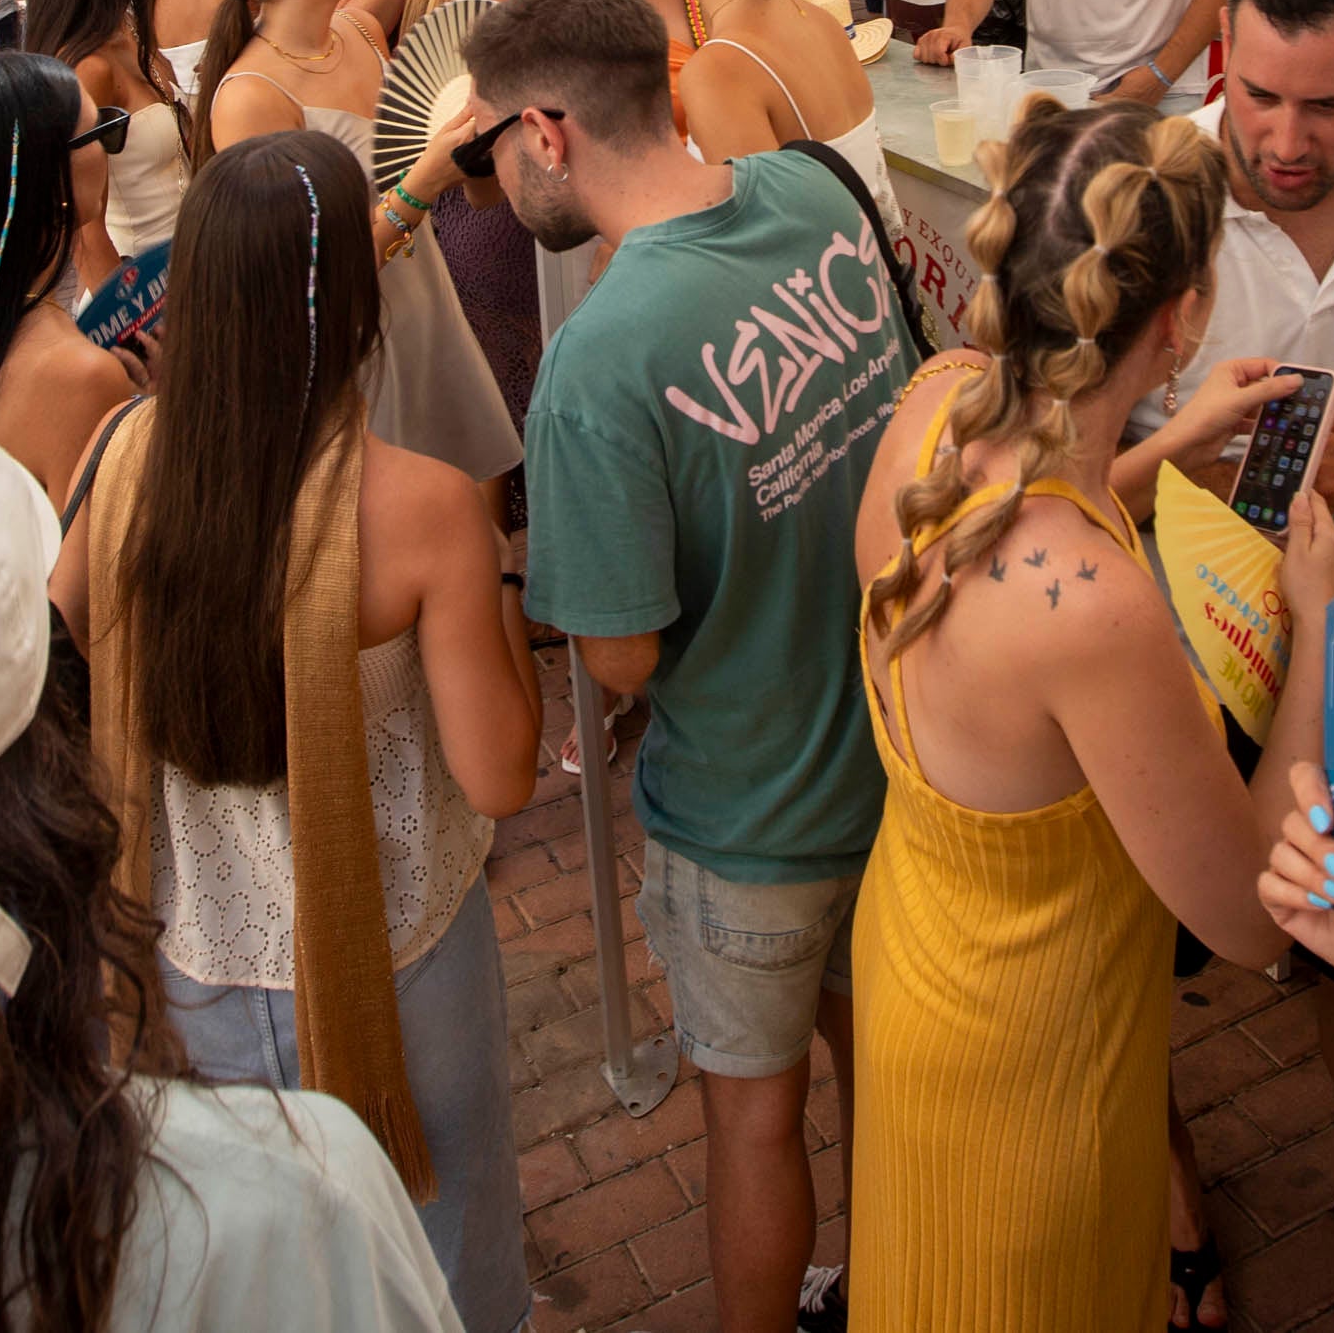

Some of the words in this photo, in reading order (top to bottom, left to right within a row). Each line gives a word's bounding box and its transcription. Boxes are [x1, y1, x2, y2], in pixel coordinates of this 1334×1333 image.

[918, 218, 976, 293] EXQUI
[88, 305, 133, 347] OME
[131, 291, 145, 315] Y
[748, 442, 797, 487] Santa
[843, 371, 869, 403] Los
[756, 441, 825, 506] California
[760, 502, 782, 522] The
